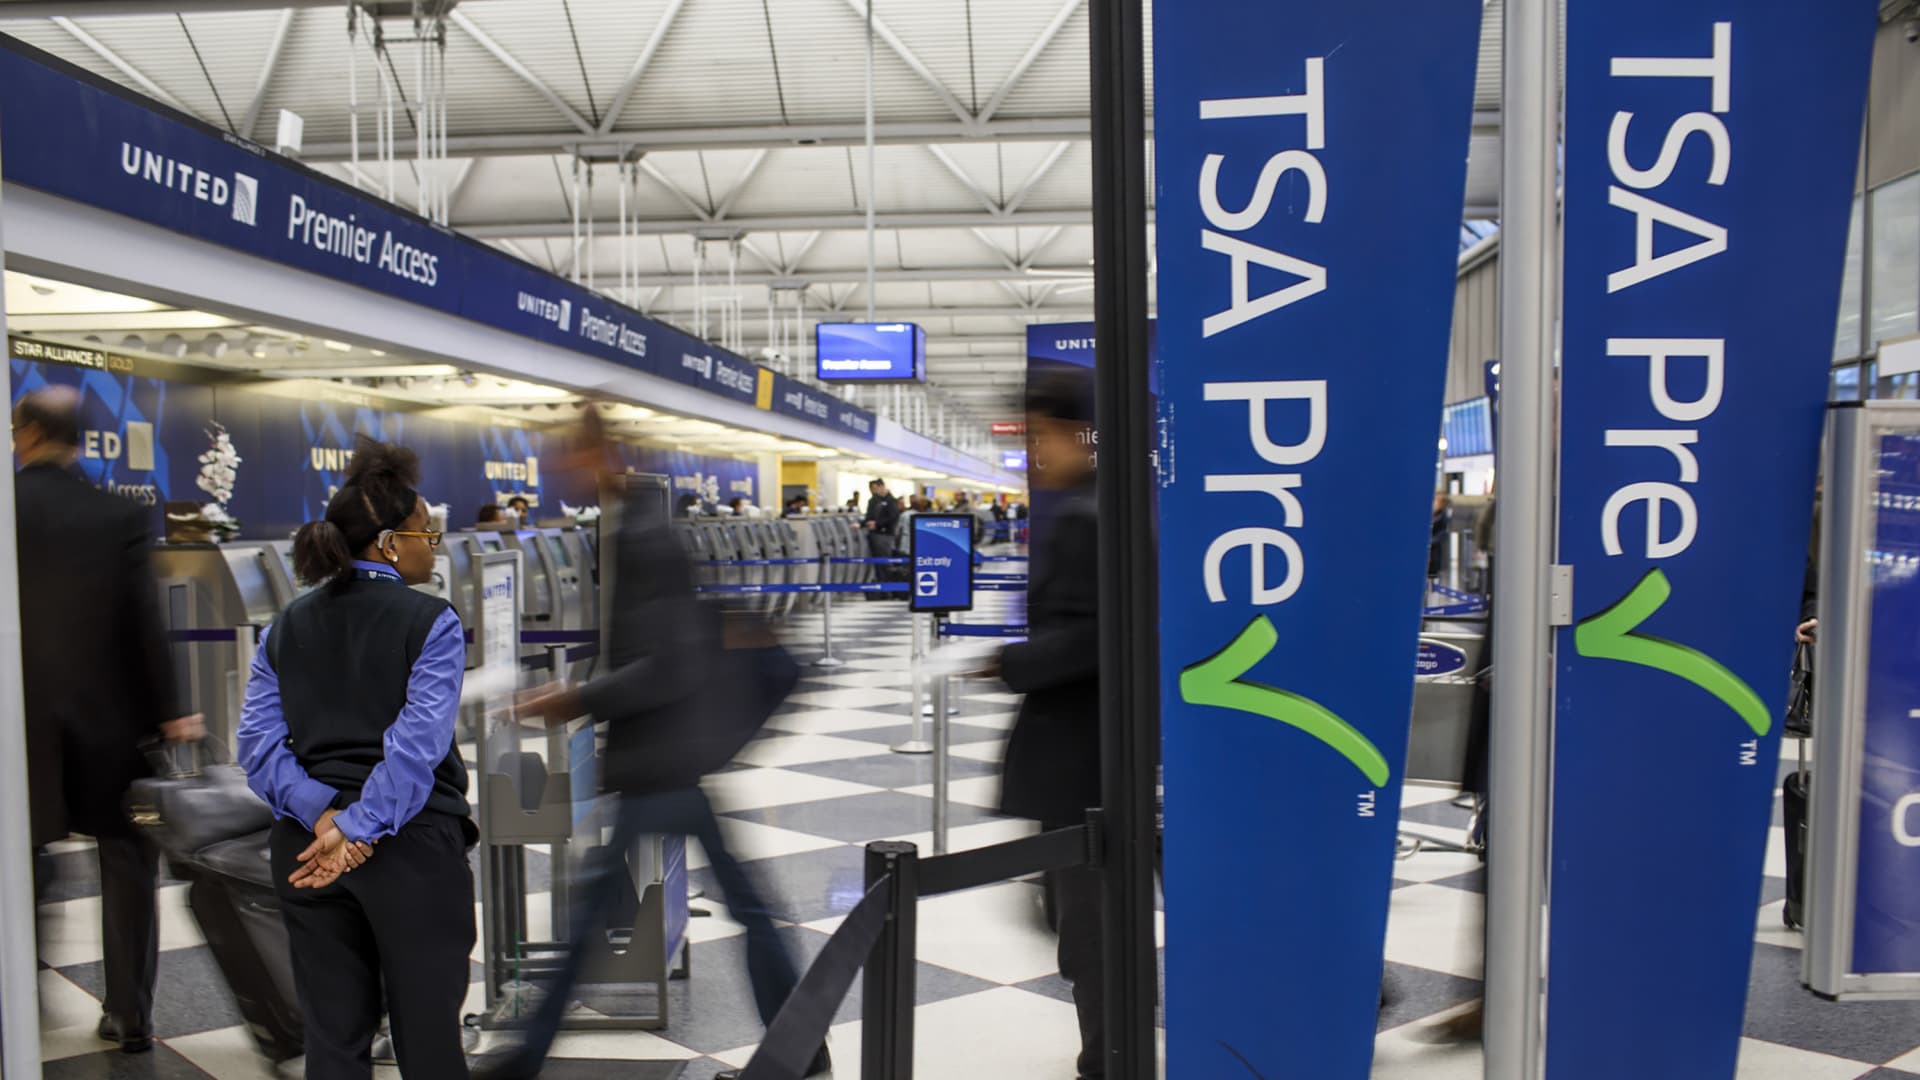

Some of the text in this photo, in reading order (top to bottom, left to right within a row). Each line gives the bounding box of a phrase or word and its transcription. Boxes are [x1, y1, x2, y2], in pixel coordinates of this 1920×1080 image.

[121, 142, 438, 287] UNITED Premier Access
[1601, 22, 1731, 559] TSA Pre
[517, 291, 647, 357] UNITED Premier Access
[1199, 57, 1327, 605] TSA Pre
[14, 341, 42, 356] STAR
[45, 346, 94, 366] ALLIANCE
[1055, 338, 1096, 350] UNIT
[311, 448, 354, 471] UNIT
[485, 461, 527, 480] UNITED
[916, 556, 952, 568] Exit only
[1741, 739, 1757, 765] TM
[1358, 790, 1375, 817] TM
